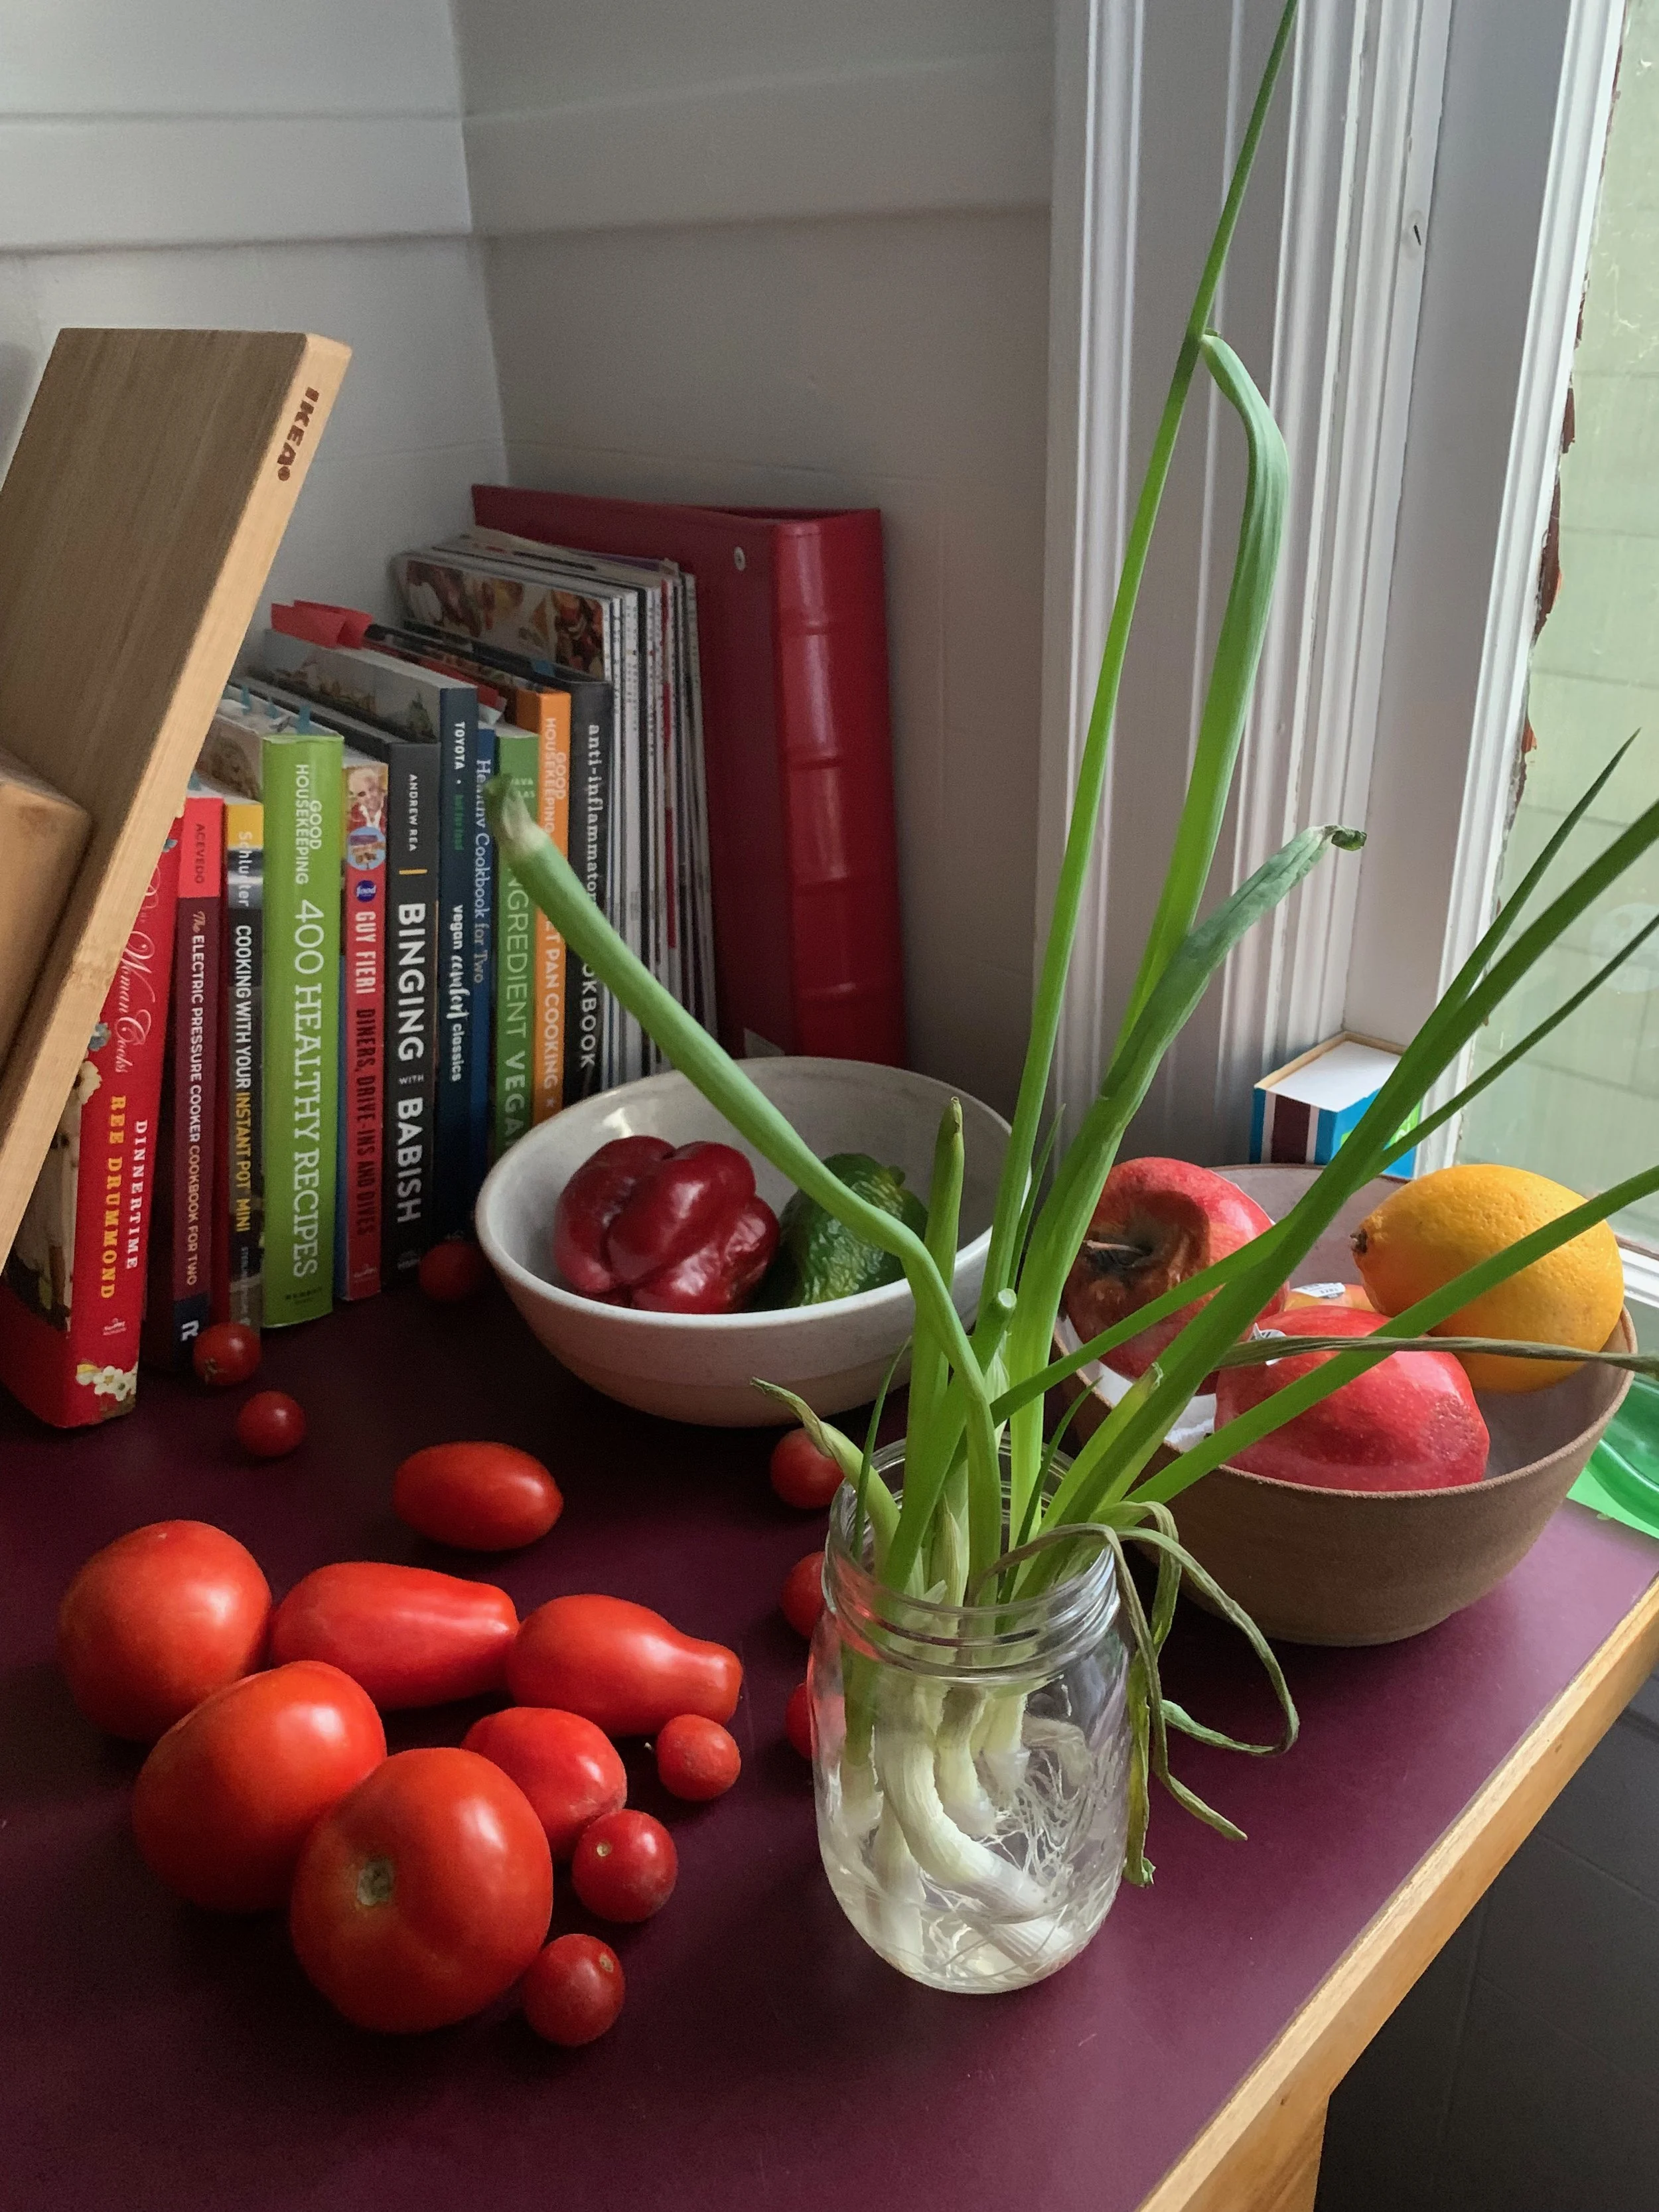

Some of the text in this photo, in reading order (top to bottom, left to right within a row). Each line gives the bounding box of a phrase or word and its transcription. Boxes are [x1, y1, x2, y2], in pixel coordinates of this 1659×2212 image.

[277, 387, 319, 466] IKEA
[455, 721, 465, 769] TOYOTA
[543, 717, 557, 834] HOUSEKEEPING
[555, 751, 567, 800] GOOD
[195, 824, 206, 884] ACEVEDO
[295, 764, 310, 885] HOUSEKEEPING
[309, 800, 323, 849] GOOD
[408, 774, 419, 852] ANDREW REA
[587, 724, 603, 903] anti-inflammator
[474, 832, 490, 919] Cookbook
[294, 899, 325, 974] 400
[355, 910, 377, 995] GUY FIERI
[450, 905, 464, 950] vegan
[473, 949, 489, 984] Two
[474, 921, 490, 946] for
[546, 947, 561, 989] PAN
[118, 930, 156, 1014] Woman
[398, 903, 427, 1062] BINGING
[235, 924, 252, 1232] COOKING WITH YOUR INSTANT POT MINI
[293, 983, 322, 1142] HEALTHY
[355, 1008, 376, 1072] DINERS,
[399, 1074, 424, 1085] WITH
[451, 1023, 465, 1082] classics
[543, 993, 560, 1089] COOKING
[186, 910, 206, 1286] The ELECTRIC PRESSURE COOKER COOKBOOK FOR TWO
[356, 1074, 376, 1157] DRIVE-INS
[504, 1051, 526, 1139] VEGA
[100, 1095, 126, 1299] REE DRUMMOND
[125, 1119, 148, 1270] DINNERTIME
[356, 1161, 376, 1188] AND
[397, 1097, 423, 1224] BABISH
[292, 1147, 321, 1278] RECIPES
